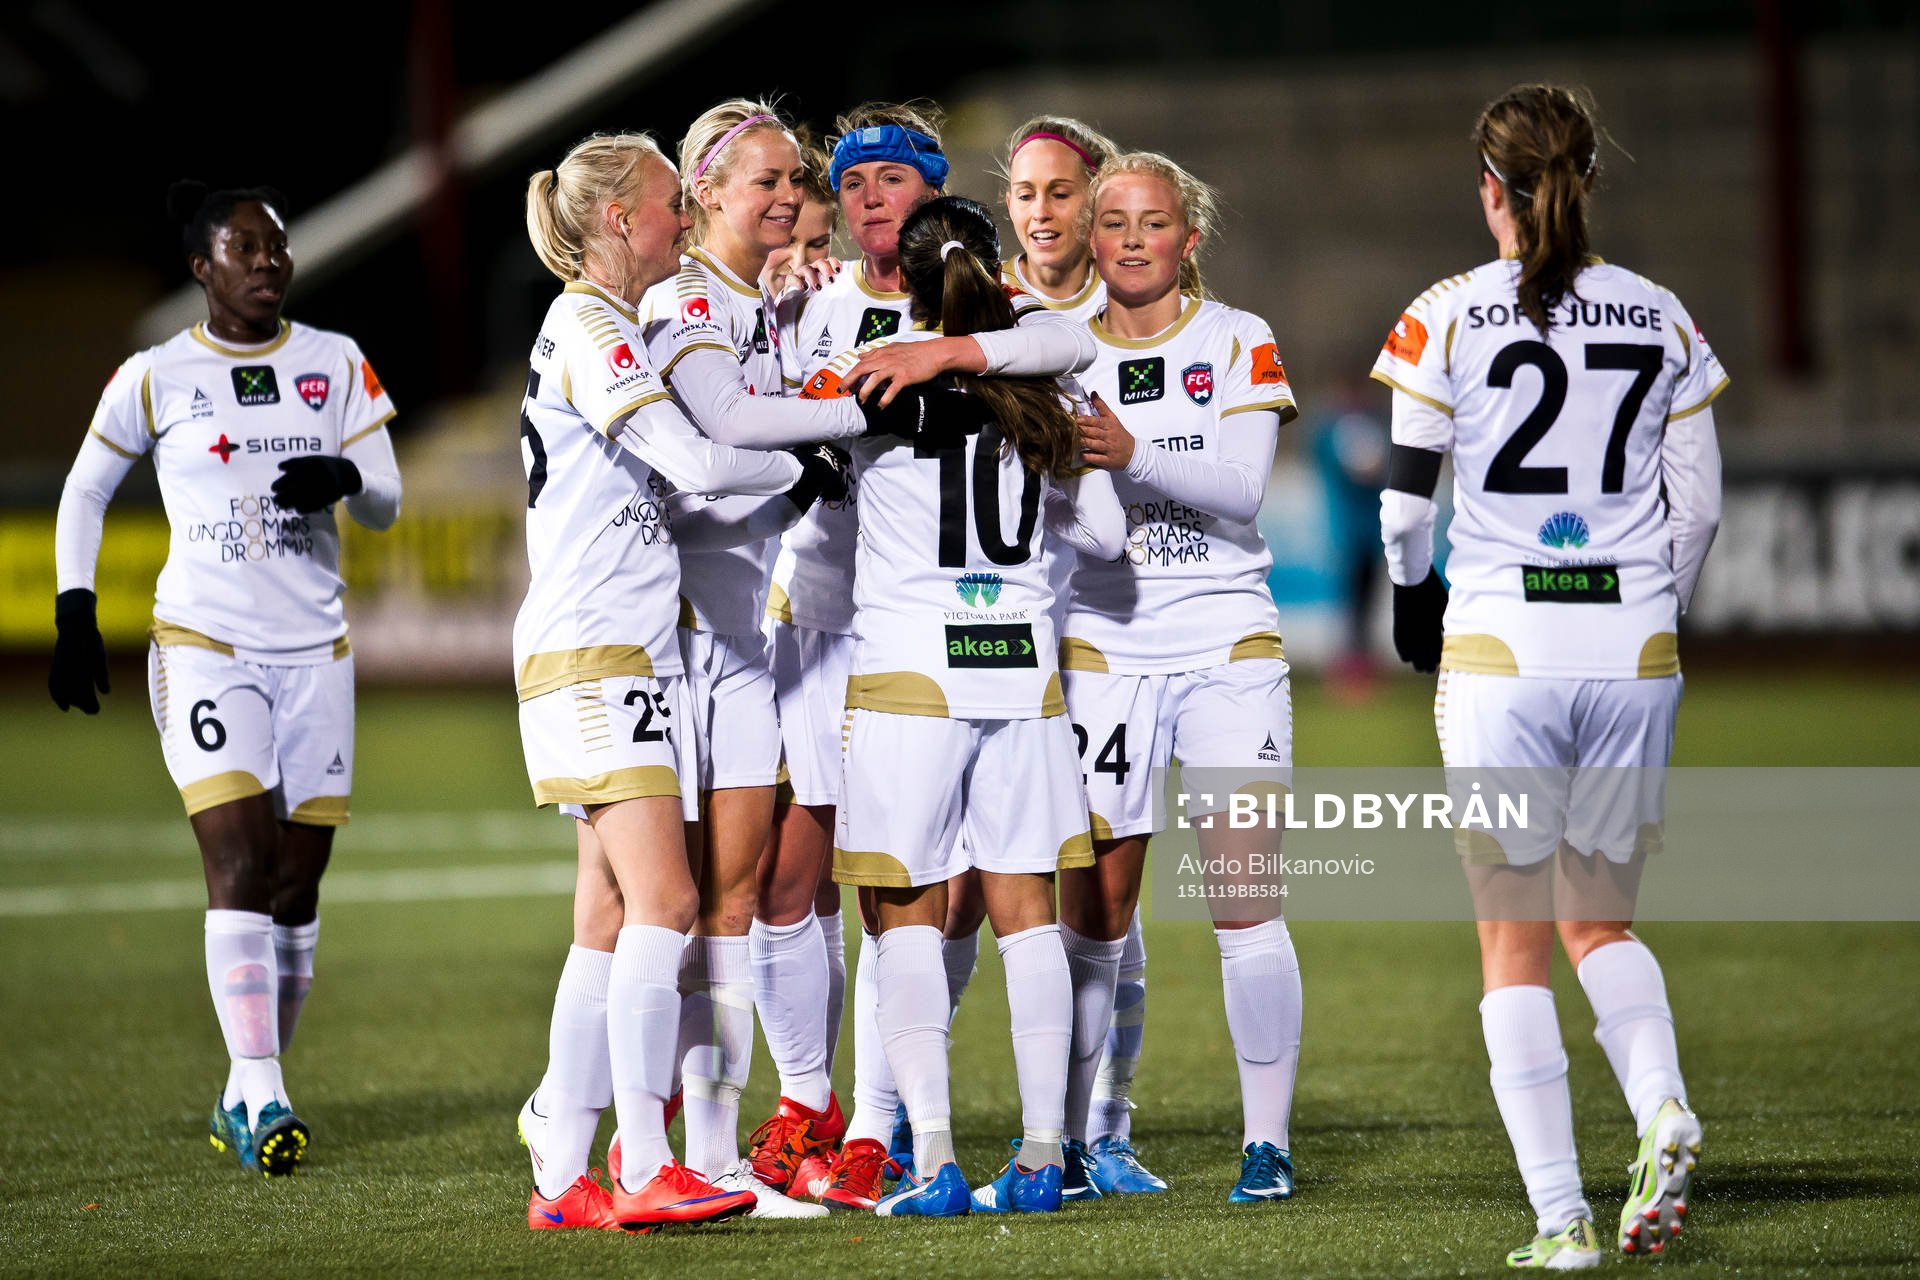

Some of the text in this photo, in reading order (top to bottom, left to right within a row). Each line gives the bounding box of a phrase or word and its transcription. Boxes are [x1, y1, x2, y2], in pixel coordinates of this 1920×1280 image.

[1566, 303, 1662, 332] JUNGE
[671, 322, 707, 341] SVENSKA
[300, 380, 326, 393] FCR
[606, 372, 640, 395] SVENSKA
[1124, 387, 1160, 401] MIKZ
[241, 392, 275, 403] MIKZ
[1483, 340, 1664, 494] 27
[520, 367, 548, 509] 5
[913, 424, 1041, 568] 10
[189, 517, 310, 542] UNGDOMARS
[1525, 568, 1589, 591] akea
[944, 610, 1026, 621] VICTORIA PARK
[949, 635, 1009, 656] akea
[190, 699, 227, 752] 6
[624, 690, 672, 745] 25
[1072, 723, 1131, 785] 24
[1257, 752, 1281, 763] SELECT
